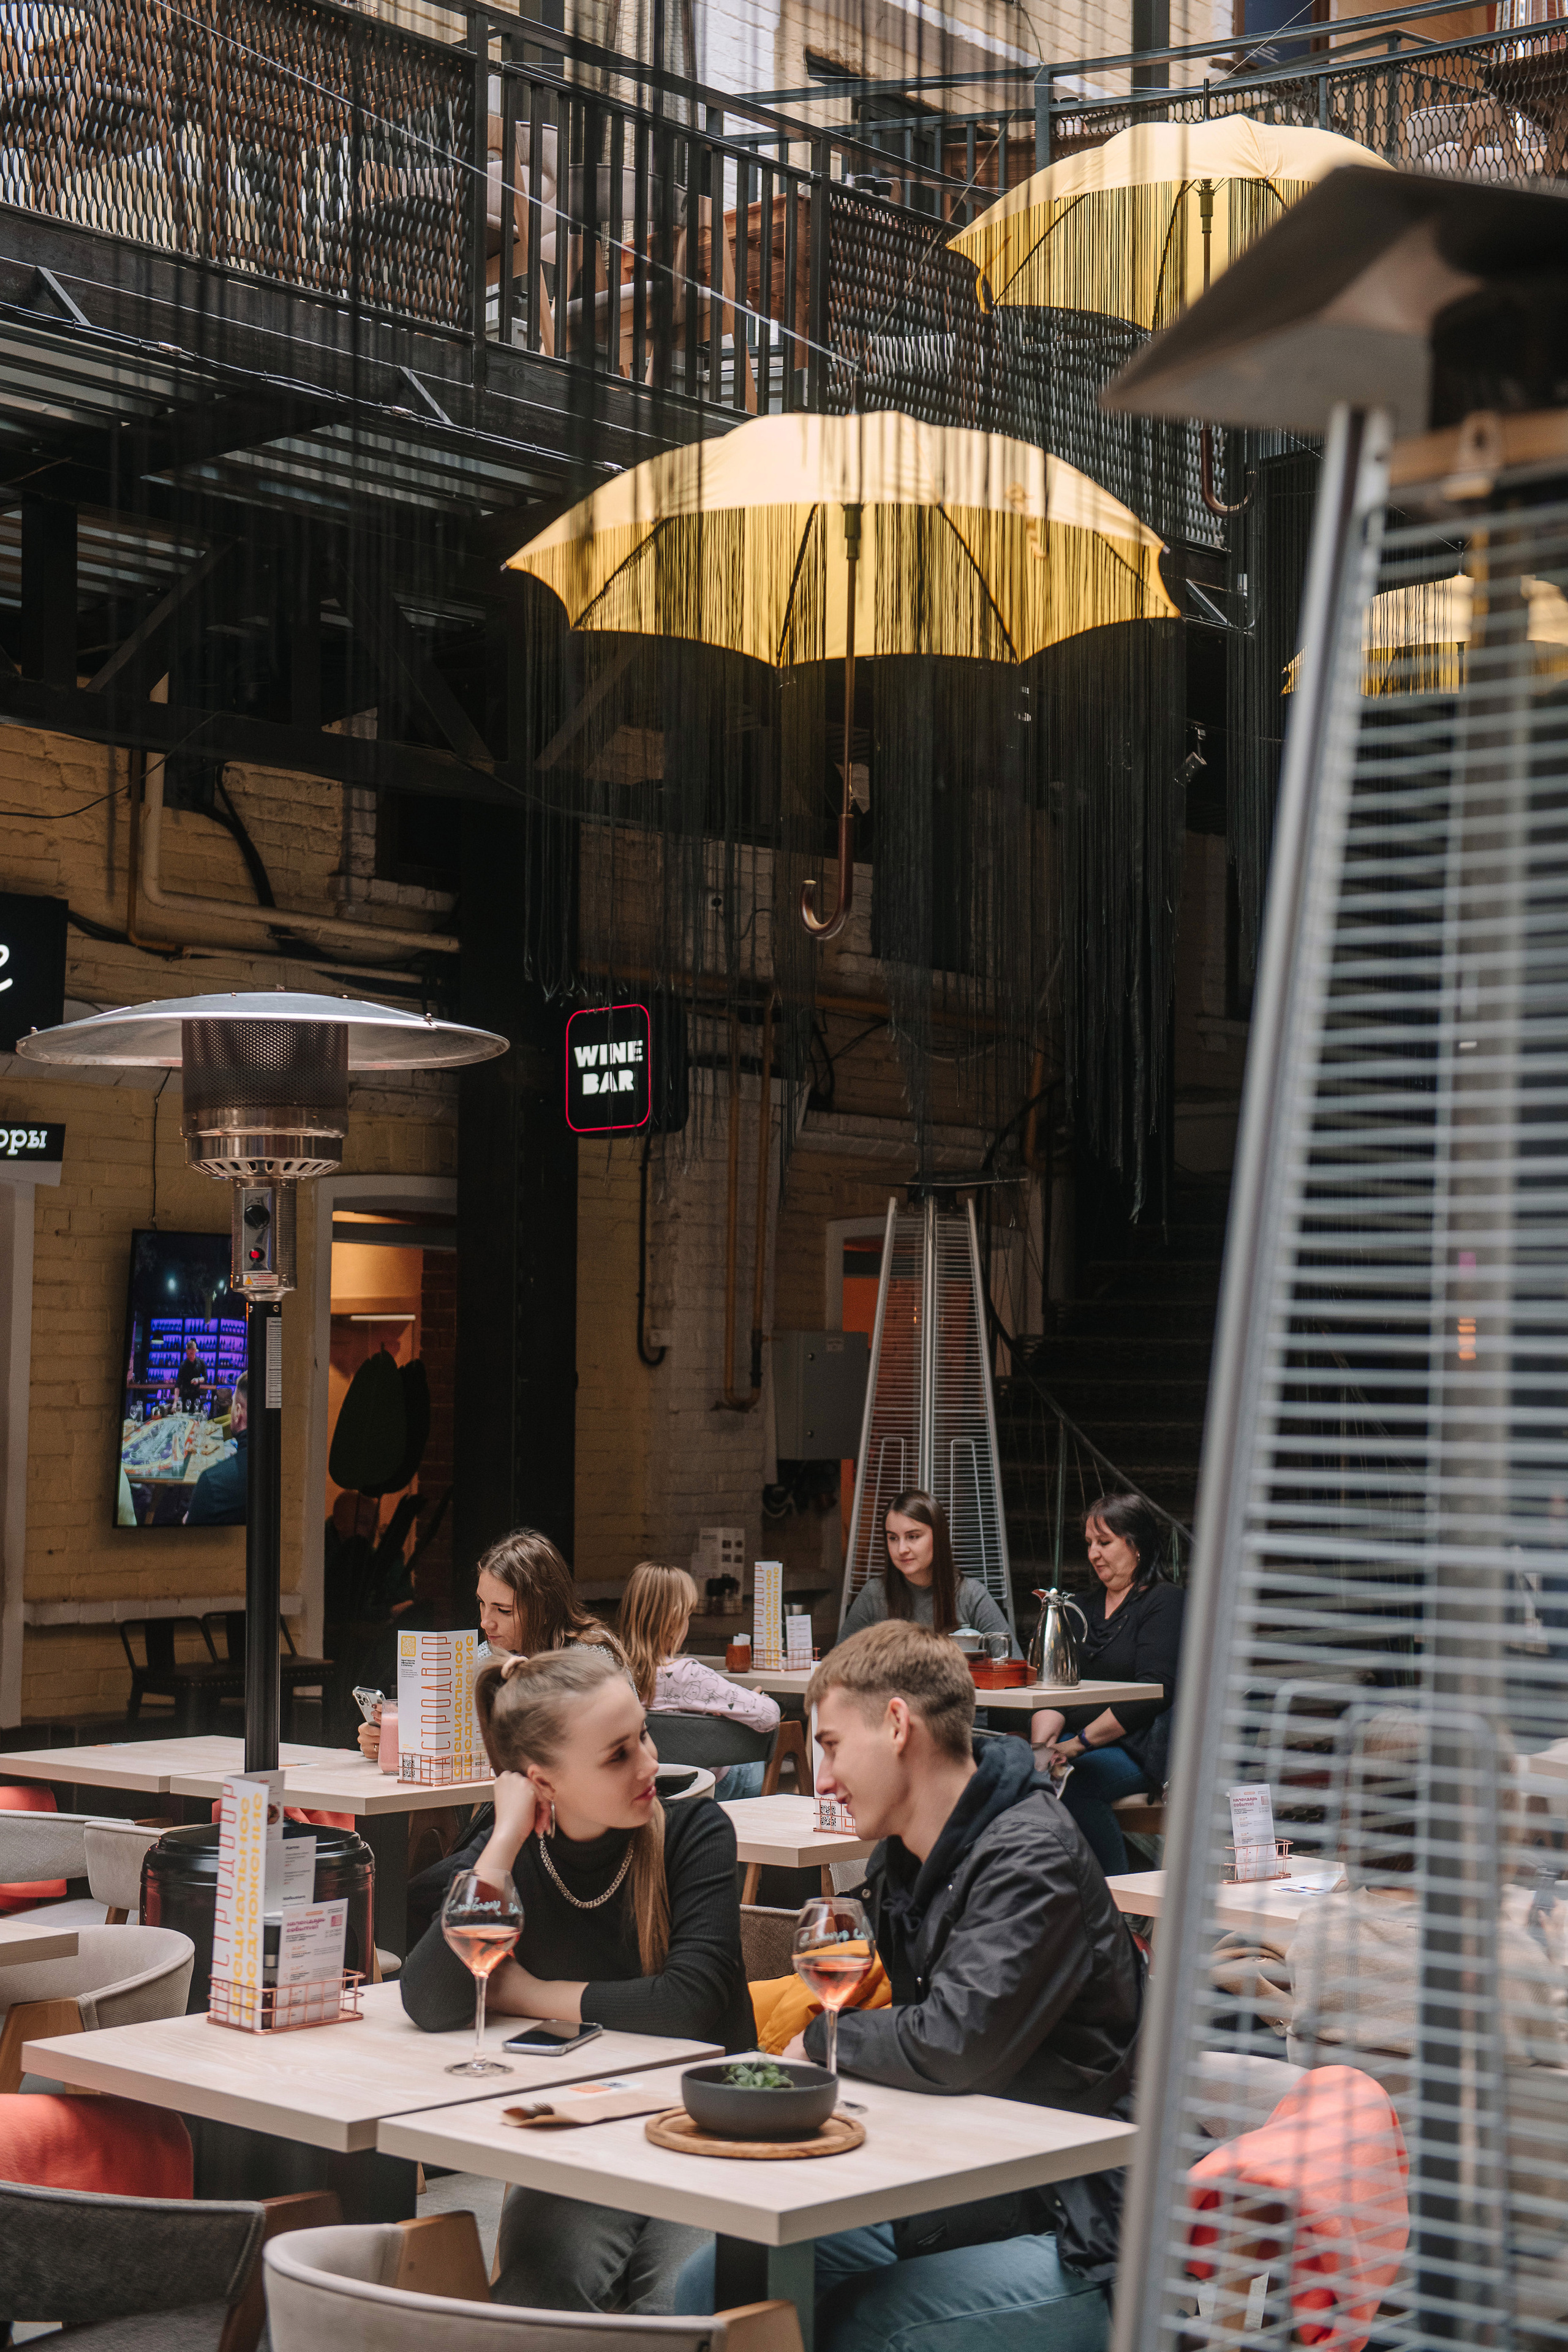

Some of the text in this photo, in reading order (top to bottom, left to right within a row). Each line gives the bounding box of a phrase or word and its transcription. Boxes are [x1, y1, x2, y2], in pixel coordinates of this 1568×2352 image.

[574, 1040, 643, 1068] WINE
[582, 1069, 635, 1095] BAR
[420, 1636, 453, 1781] ГАСТРОДВОР
[454, 1640, 463, 1777] специальное
[464, 1635, 474, 1776] предложение
